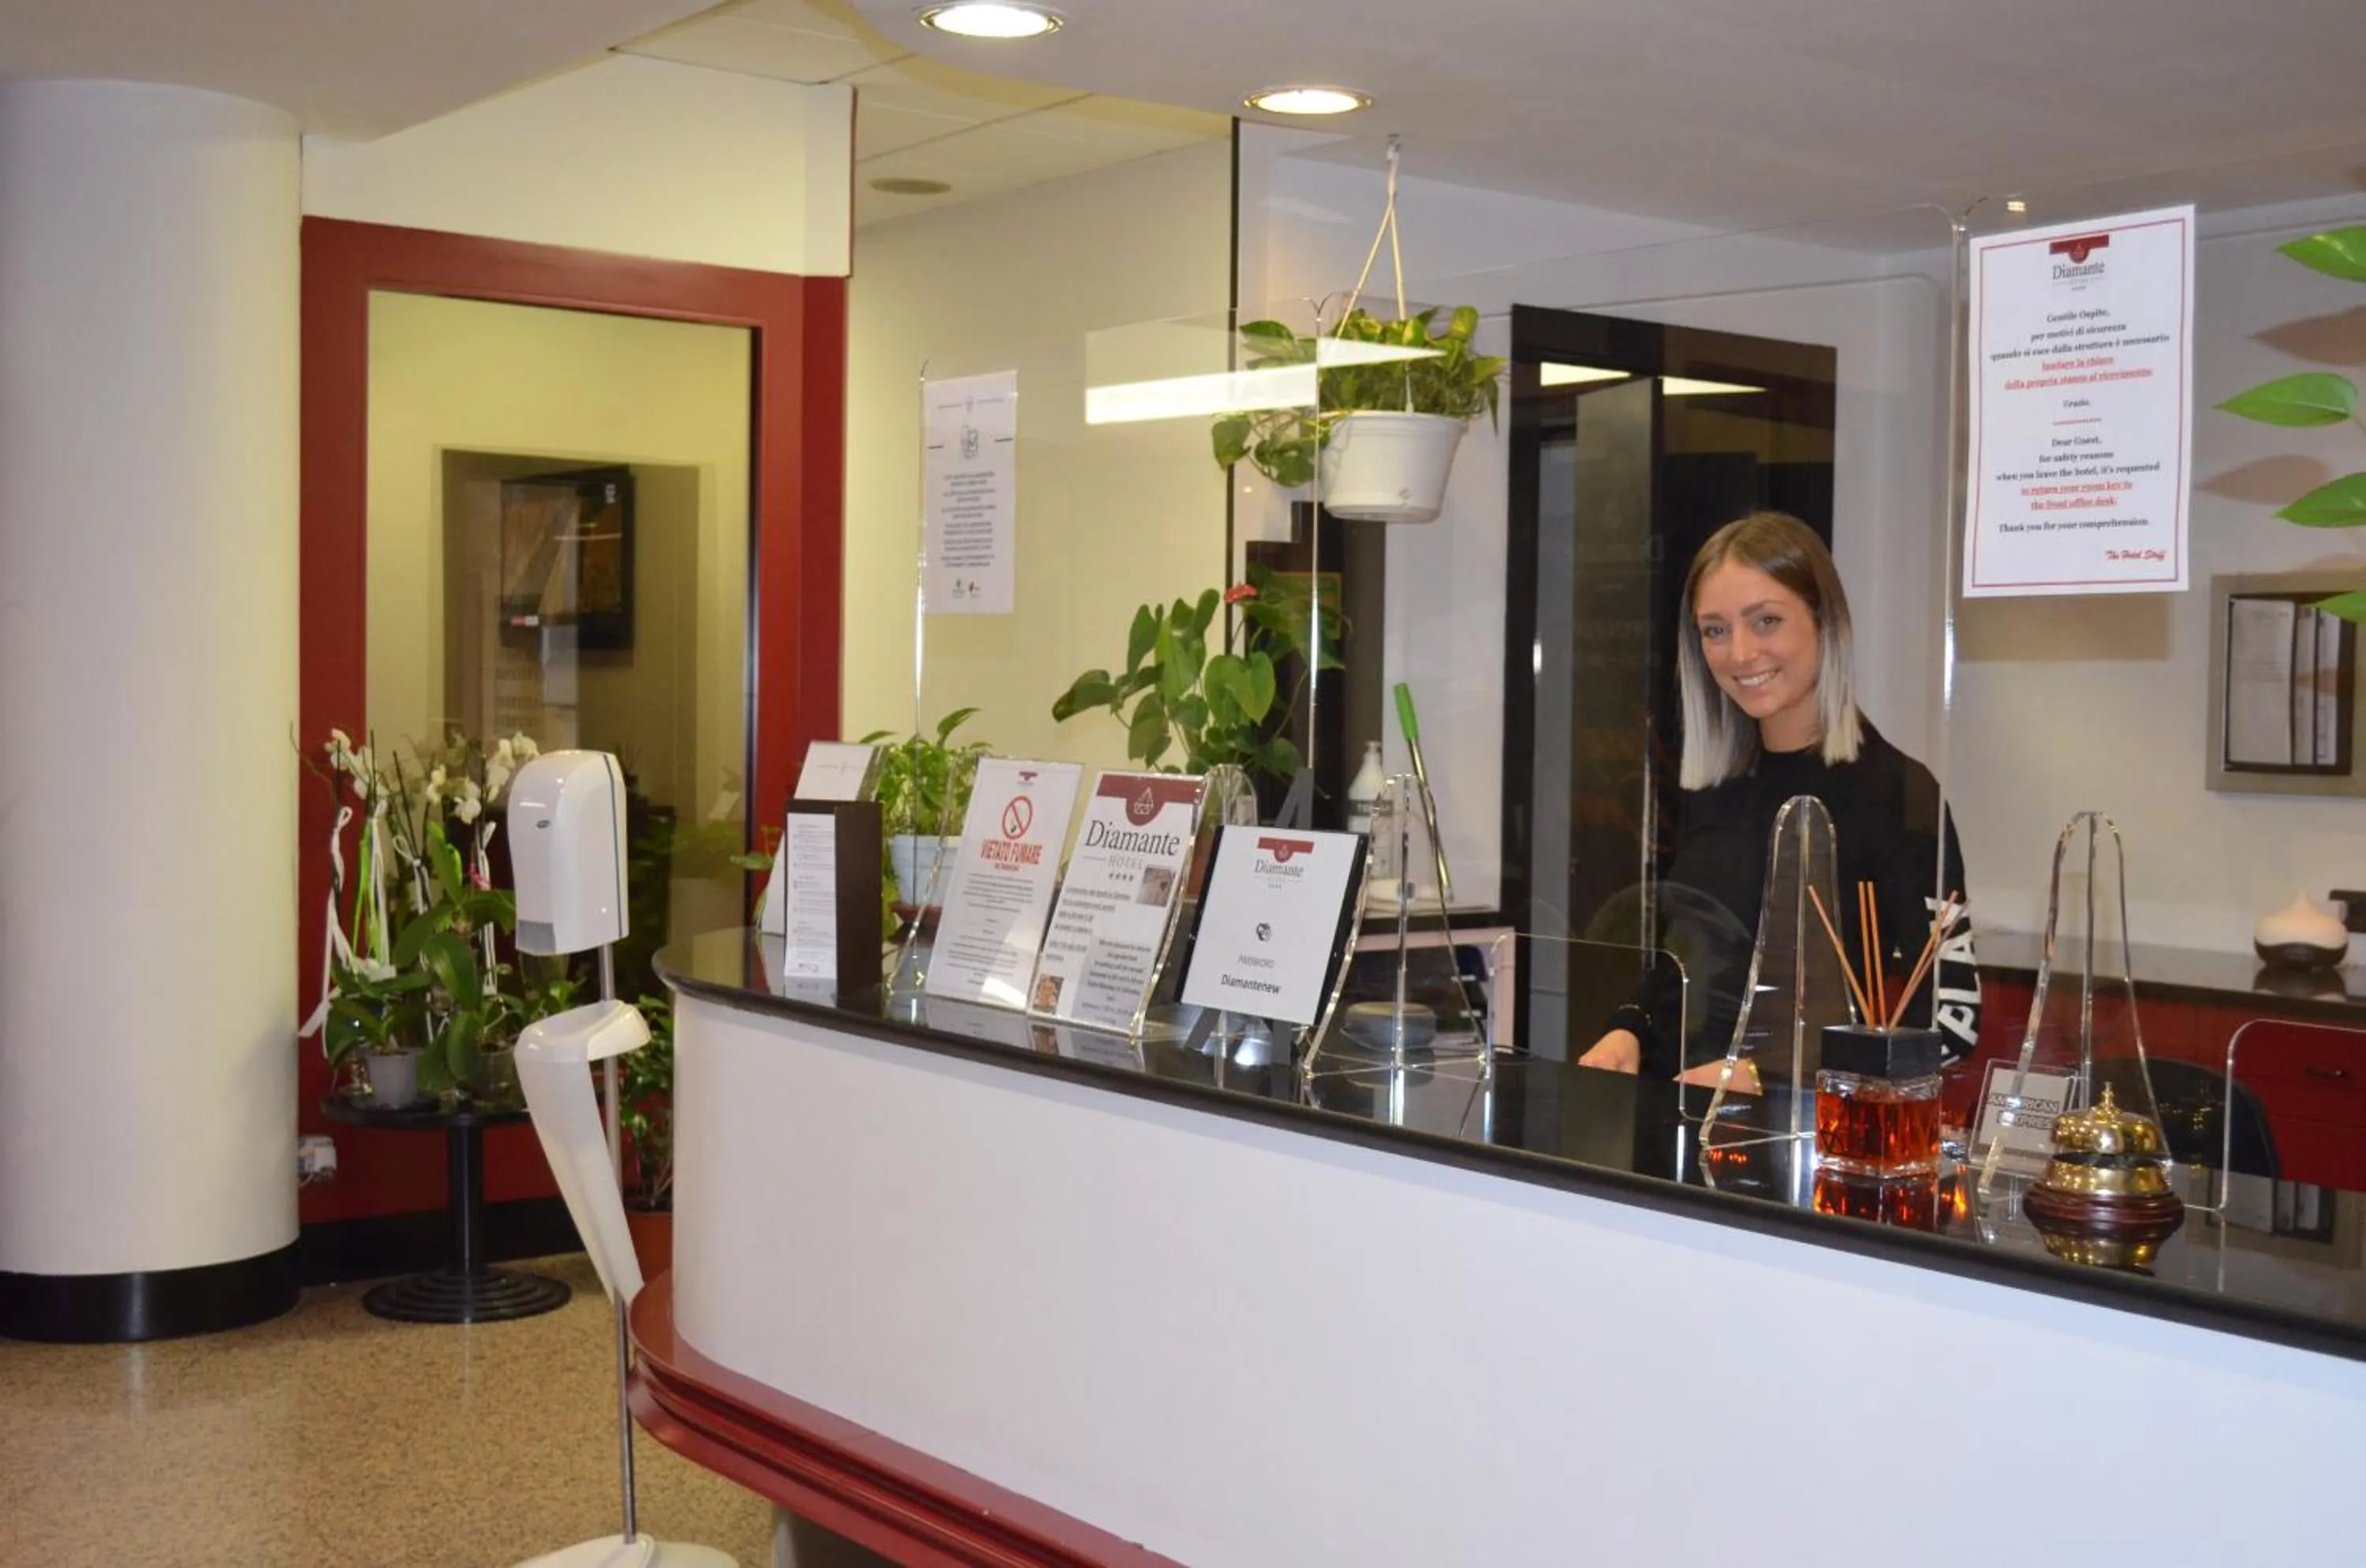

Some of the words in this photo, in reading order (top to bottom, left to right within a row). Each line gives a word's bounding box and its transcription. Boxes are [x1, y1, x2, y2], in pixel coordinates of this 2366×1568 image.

[2052, 261, 2106, 280] Diamante
[2030, 331, 2045, 342] per
[2047, 327, 2074, 339] motivi
[2075, 326, 2084, 336] di
[2086, 323, 2127, 334] sicurezza
[2023, 349, 2031, 357] si
[2051, 342, 2073, 354] dalla
[2073, 339, 2114, 352] struttura
[2051, 437, 2072, 448] Dear
[2039, 454, 2052, 464] for
[2053, 452, 2079, 465] safety
[2080, 450, 2114, 461] reasons
[1995, 470, 2017, 482] when
[2018, 472, 2035, 482] you
[2036, 468, 2058, 480] leave
[2058, 466, 2073, 477] the
[2073, 464, 2099, 477] hotel,
[2115, 461, 2161, 476] requested
[2081, 483, 2105, 494] room
[2030, 499, 2044, 511] the
[2046, 498, 2067, 510] front
[2068, 497, 2093, 509] office
[1999, 521, 2025, 533] Thank
[2025, 522, 2042, 532] you
[2043, 521, 2056, 531] for
[2057, 521, 2078, 531] your
[2078, 517, 2151, 530] comprehension.
[2105, 550, 2121, 561] The
[1084, 819, 1181, 856] Diamante
[980, 838, 1011, 862] VIETATO
[1009, 842, 1043, 865] FUMARE
[1108, 855, 1144, 870] HOTEL
[1254, 858, 1304, 878] Diamante
[1221, 974, 1282, 994] Diamantenew
